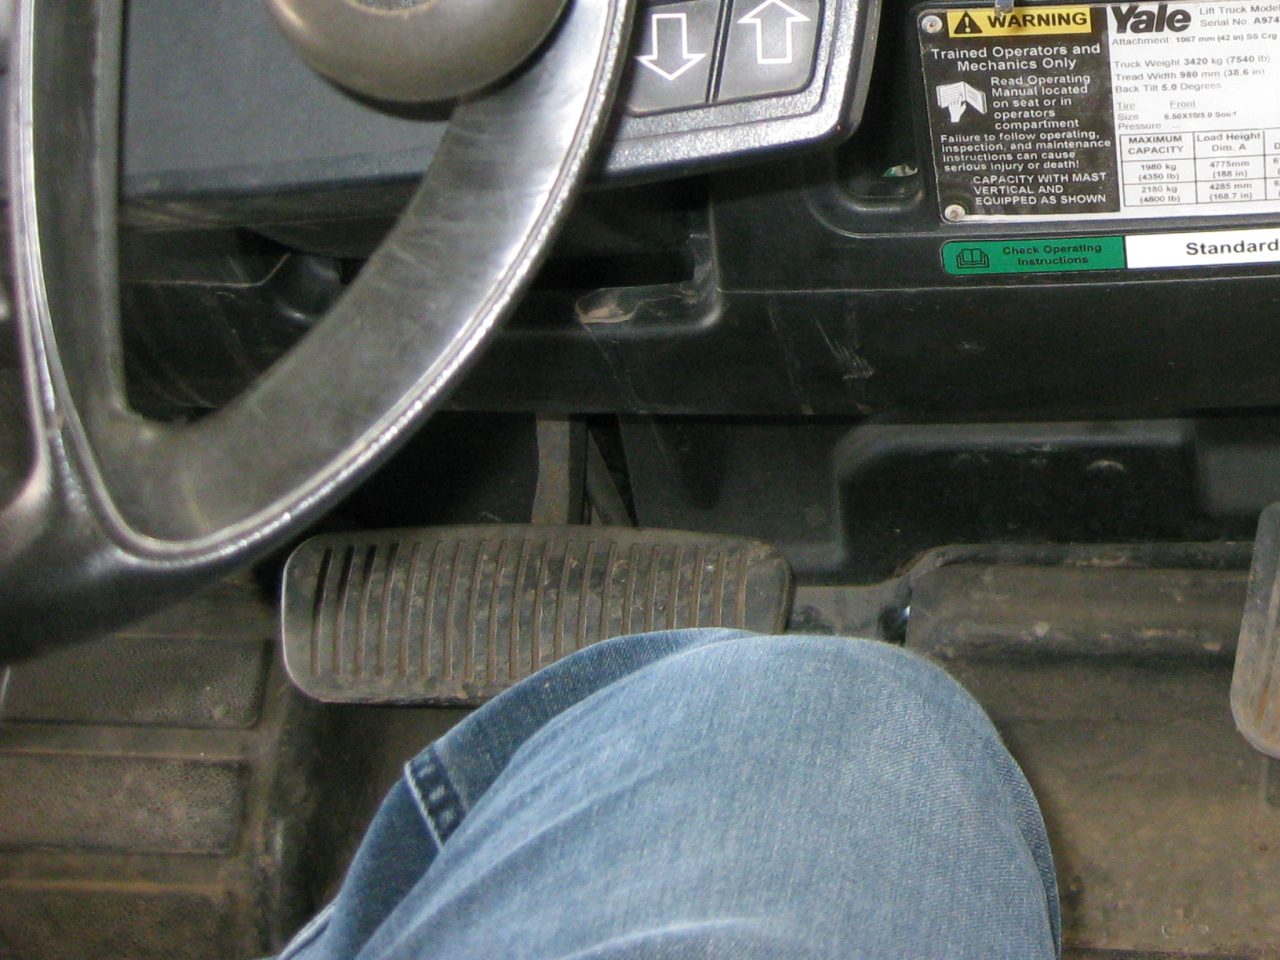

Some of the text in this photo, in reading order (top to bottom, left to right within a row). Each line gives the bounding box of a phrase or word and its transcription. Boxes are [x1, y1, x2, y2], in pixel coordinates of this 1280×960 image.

[1200, 7, 1215, 15] Lift
[1219, 6, 1247, 14] Truck
[1251, 4, 1280, 12] Model
[987, 12, 1087, 28] WARNING
[1111, 4, 1191, 34] Yale
[1200, 19, 1229, 27] Serial
[1233, 17, 1247, 26] No
[1233, 33, 1244, 42] in)
[931, 43, 1100, 60] Trained Operators and
[958, 58, 1077, 71] Mechanics Only
[1115, 60, 1141, 68] Truck
[1145, 59, 1180, 68] Weight
[1211, 57, 1223, 65] kg
[1226, 56, 1254, 64] (7540
[1258, 55, 1270, 63] lb)
[1115, 73, 1143, 81] Tread
[1146, 71, 1176, 80] Width
[1180, 71, 1198, 79] 980
[1224, 68, 1248, 77] (38.6
[1252, 68, 1264, 76] in)
[991, 74, 1090, 88] Read Operating
[992, 84, 1088, 97] Manual located
[1115, 82, 1221, 93] Back Tilt 5.0 Degrees
[1013, 98, 1039, 107] seat
[1043, 98, 1056, 106] or
[1061, 97, 1072, 105] in
[1117, 102, 1135, 110] Tire
[1170, 100, 1195, 108] Front
[994, 110, 1055, 121] operators
[1118, 113, 1139, 121] Size
[995, 119, 1079, 131] compartment
[1118, 122, 1161, 130] Pressure
[941, 130, 1100, 143] Failure to follow operating,
[1129, 135, 1182, 144] MAXIMUM
[1197, 133, 1222, 142] Load
[1226, 132, 1260, 141] Height
[1010, 141, 1032, 150] and
[1036, 140, 1111, 150] maintenance
[1128, 146, 1184, 155] CAPACITY
[1212, 144, 1235, 152] Dim.
[1239, 143, 1246, 151] A
[943, 152, 1013, 162] instructions
[1041, 151, 1076, 159] cause
[944, 159, 1079, 172] serious injury or death!
[1141, 163, 1162, 171] 1980
[1166, 163, 1176, 171] kg
[973, 172, 1107, 184] CAPACITY WITH MAST
[1139, 173, 1163, 181] (4350
[1167, 172, 1179, 180] lb)
[1213, 170, 1232, 178] (188
[1235, 169, 1247, 177] in)
[974, 185, 1064, 195] VERTICAL AND
[1166, 185, 1177, 193] kg
[975, 194, 1106, 205] EQUIPPED AS SHOWN
[1168, 195, 1180, 203] lb)
[1240, 192, 1252, 200] in)
[1003, 244, 1102, 255] Check Operating
[1186, 239, 1279, 256] Standard
[1018, 256, 1088, 266] Instructions
